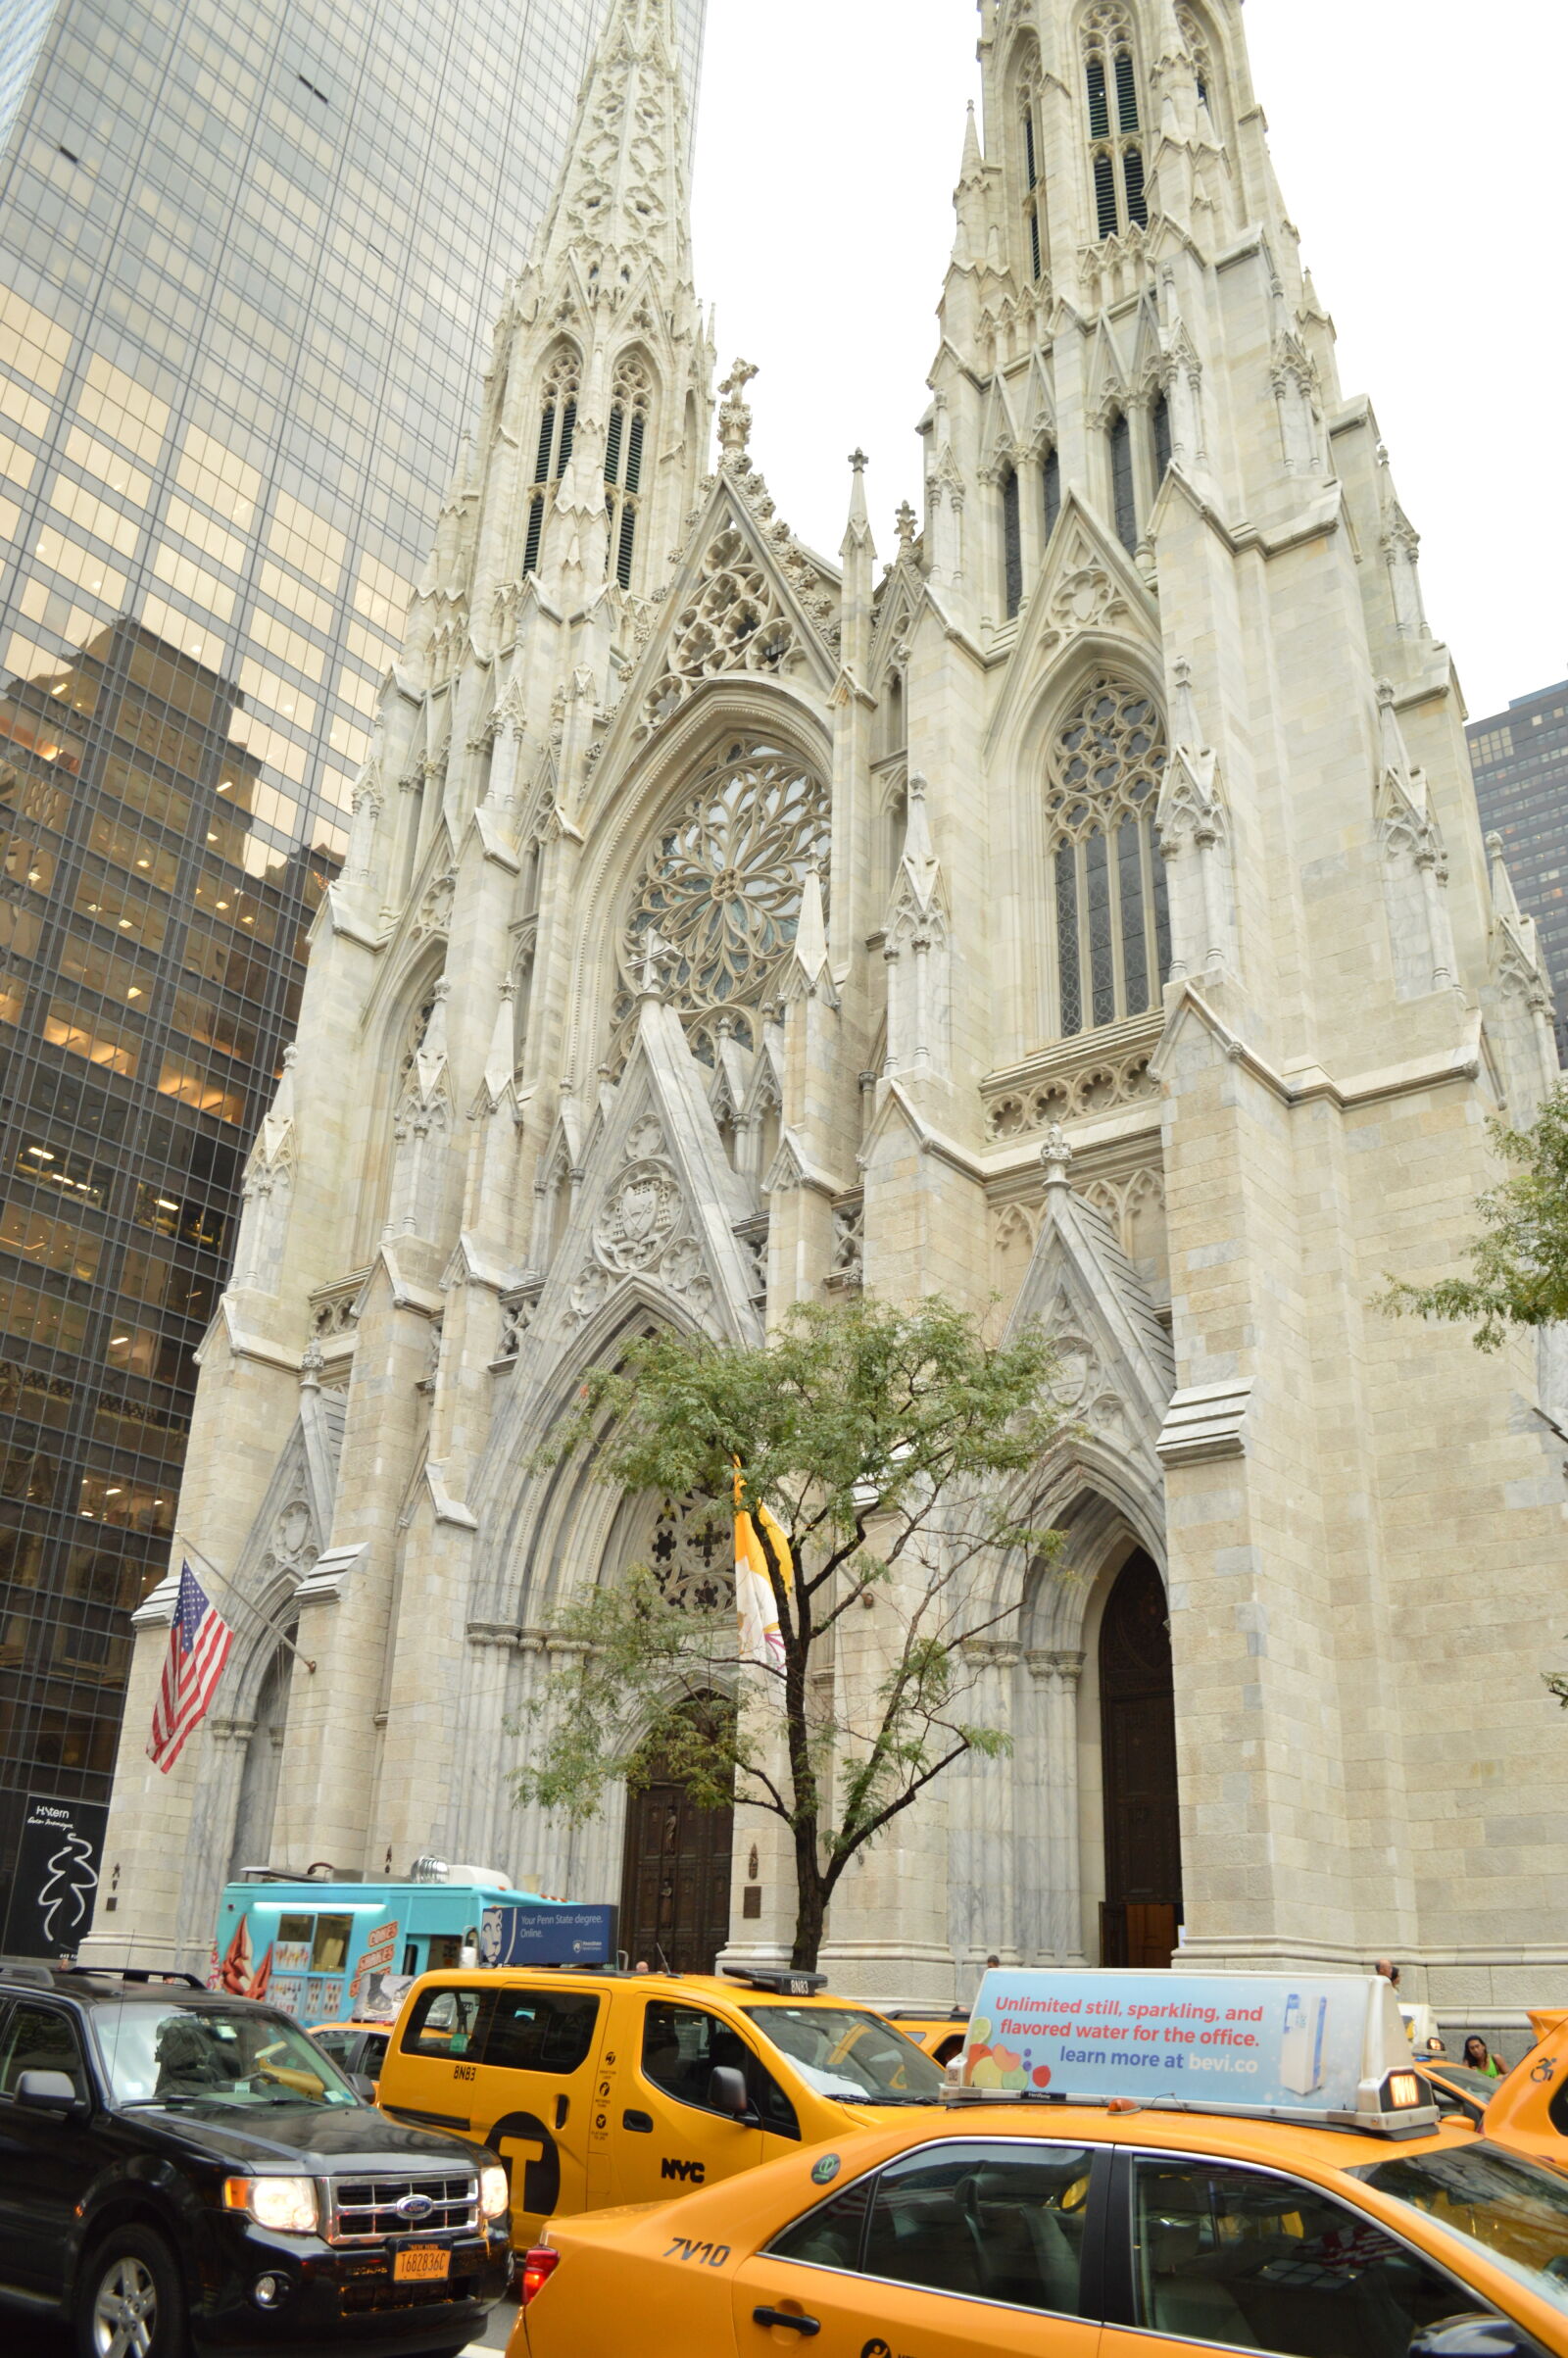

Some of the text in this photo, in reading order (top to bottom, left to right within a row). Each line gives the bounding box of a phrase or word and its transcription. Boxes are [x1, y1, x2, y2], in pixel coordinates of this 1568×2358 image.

[537, 1915, 554, 1924] Penn
[556, 1914, 573, 1924] State
[519, 1928, 544, 1938] Online.
[790, 1979, 808, 1995] 8N83
[996, 1996, 1263, 2023] Unlimited still, sparkling, and
[1000, 2019, 1260, 2048] flavored water for the office.
[1059, 2045, 1258, 2074] learn more at bevi.co
[453, 2065, 476, 2082] 8N83
[661, 2157, 706, 2184] NYC
[662, 2237, 731, 2267] 7V10
